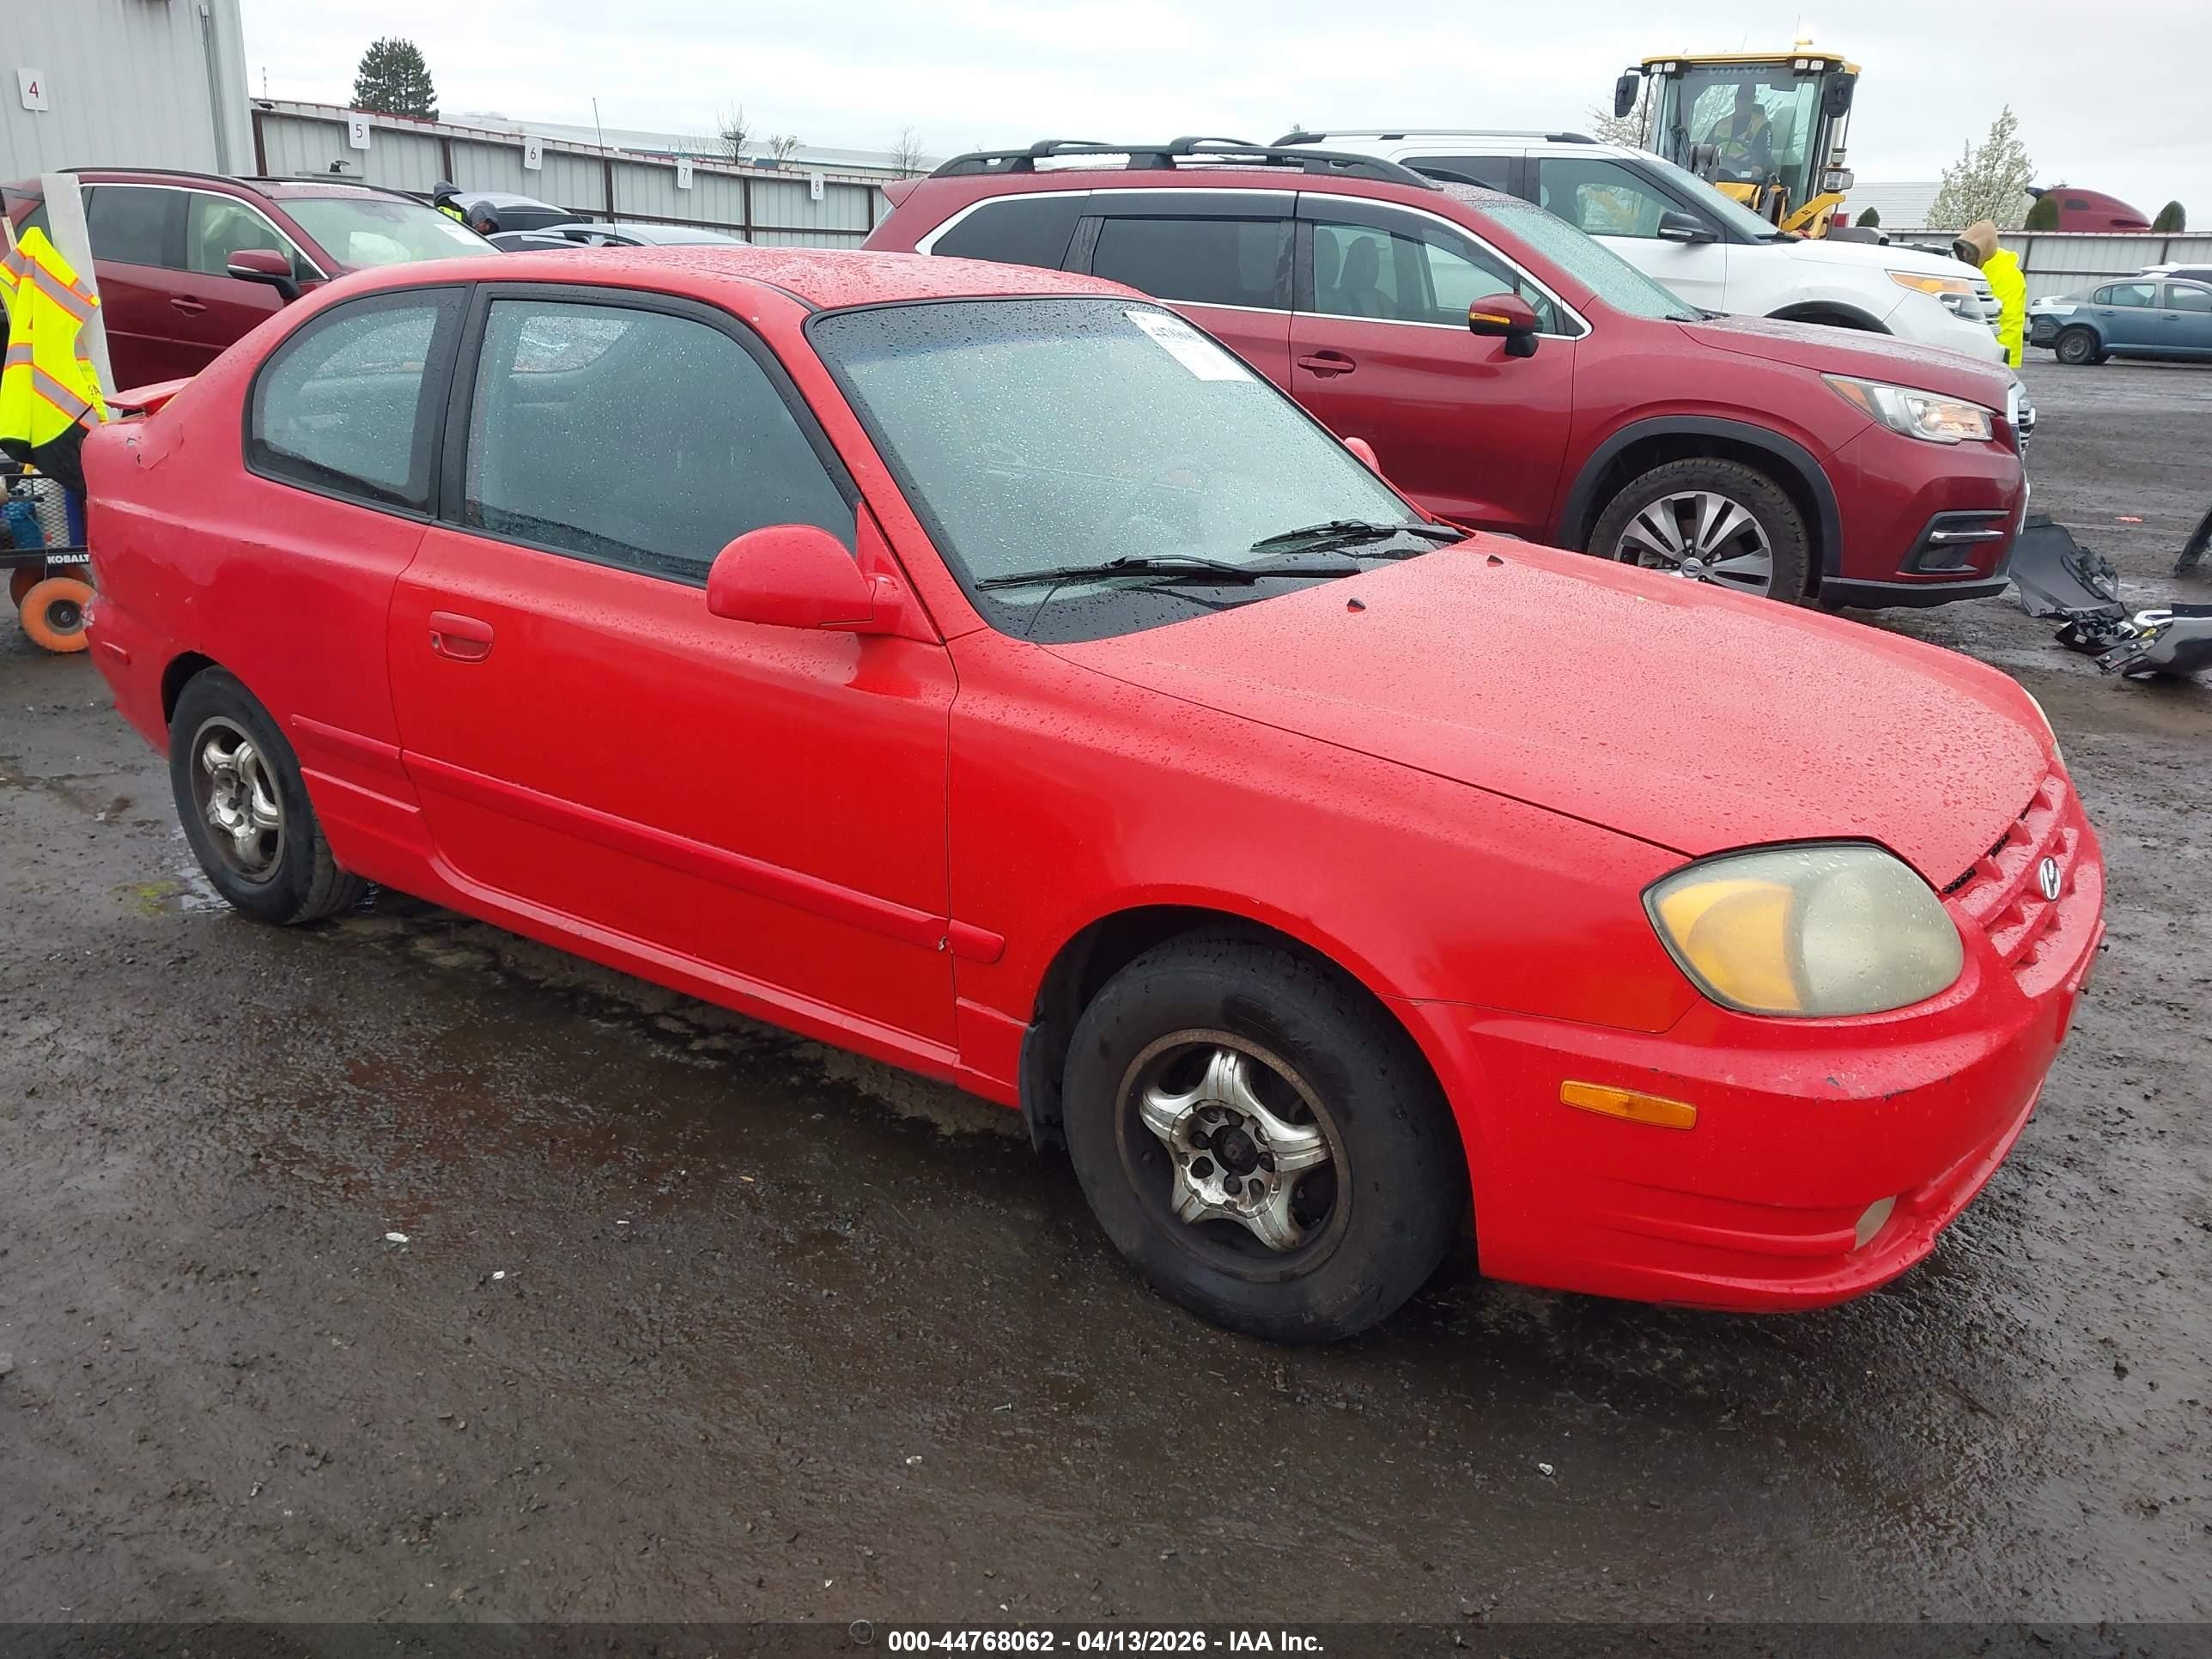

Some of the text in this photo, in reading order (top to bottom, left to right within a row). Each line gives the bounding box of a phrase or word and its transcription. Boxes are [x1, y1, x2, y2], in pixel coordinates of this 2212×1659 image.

[29, 81, 39, 99] 4
[356, 123, 363, 138] 5
[530, 147, 537, 160] 6
[683, 167, 688, 179] 7
[815, 179, 820, 192] 8
[47, 554, 90, 564] KOBALT
